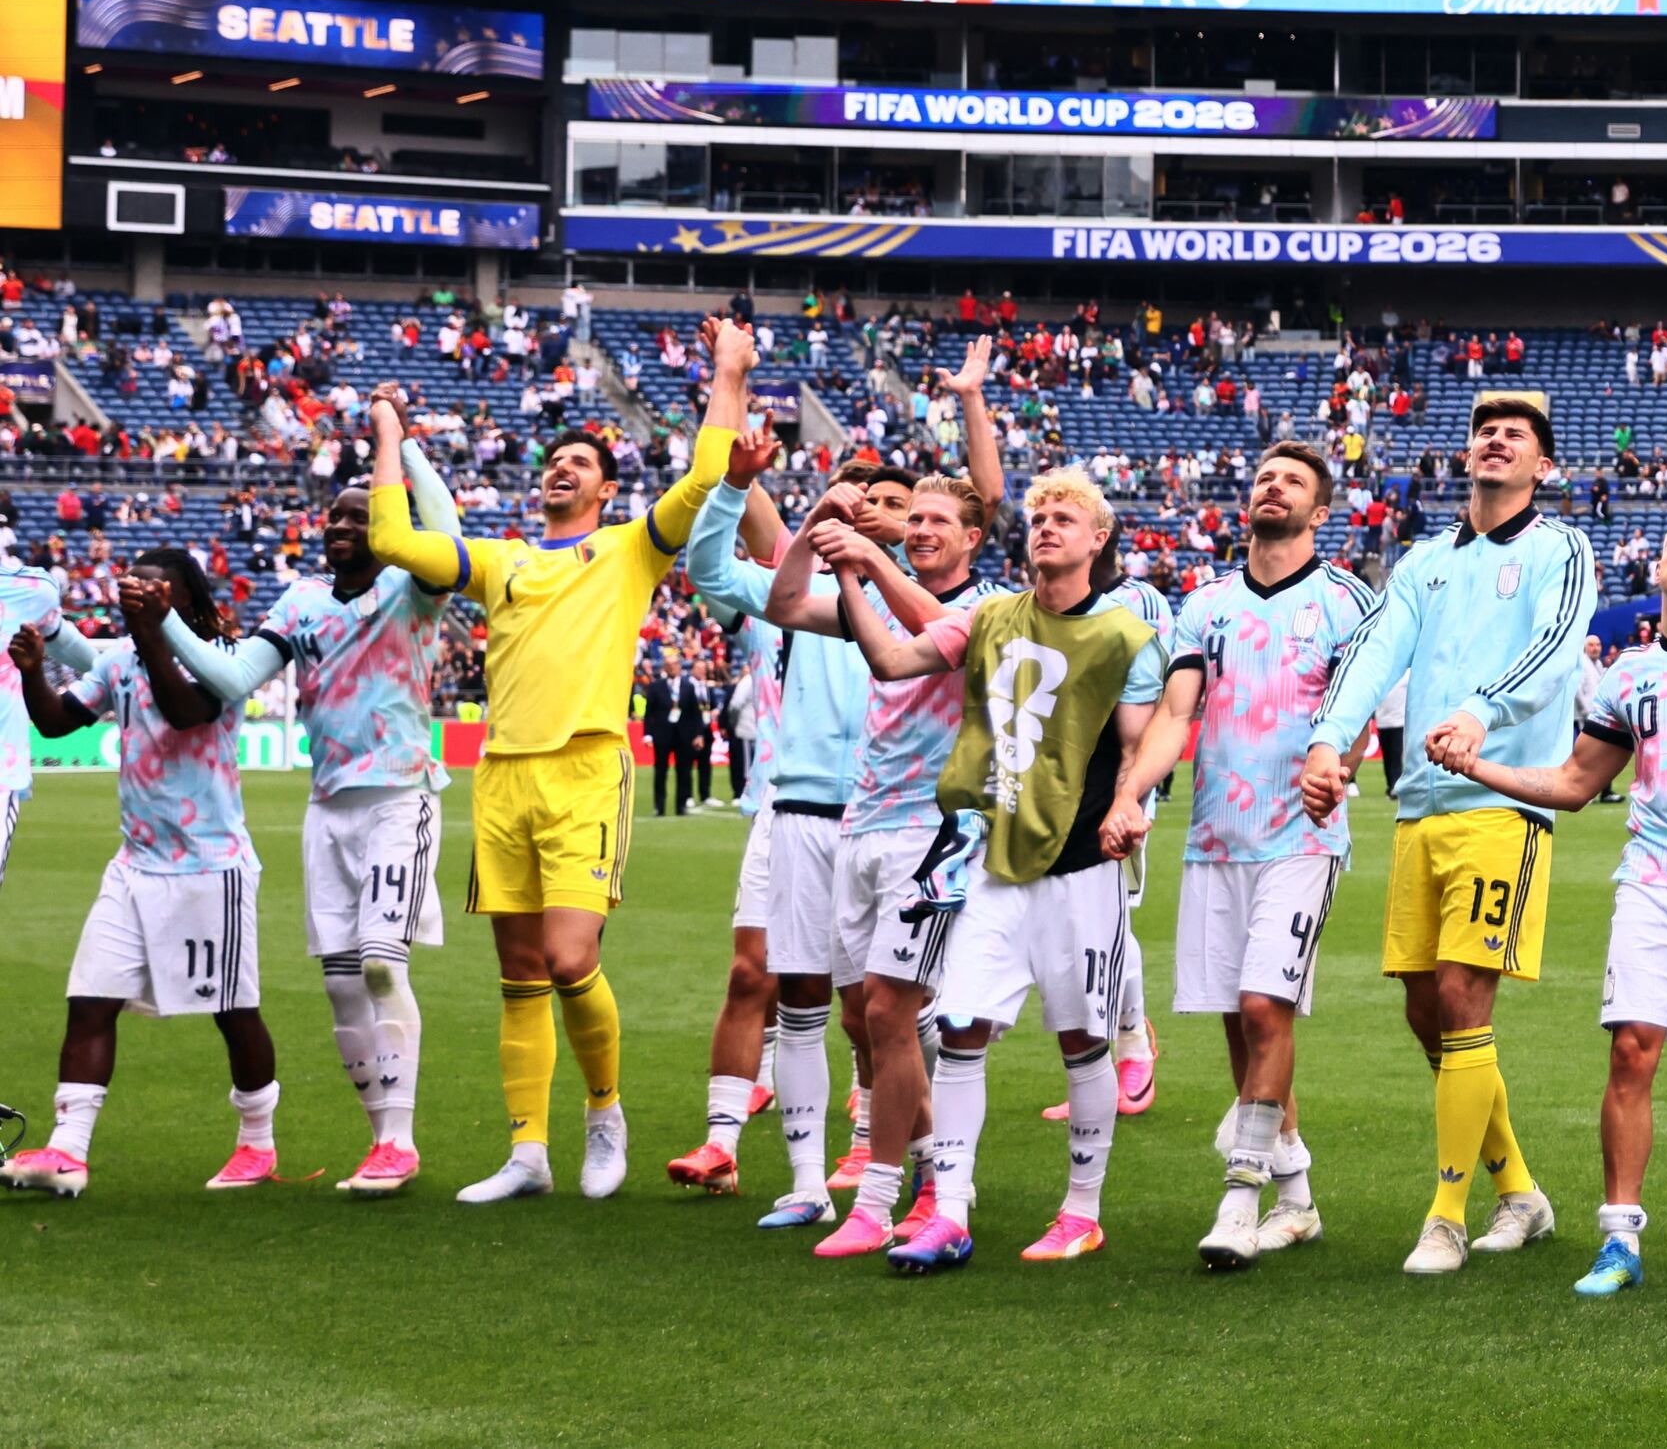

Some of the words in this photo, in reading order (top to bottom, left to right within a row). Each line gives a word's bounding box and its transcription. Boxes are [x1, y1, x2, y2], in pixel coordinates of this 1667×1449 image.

[216, 4, 415, 52] SEATTLE
[844, 92, 922, 124] FIFA
[925, 95, 1053, 126] WORLD
[1056, 96, 1130, 128] CUP
[1132, 98, 1255, 131] 2026
[309, 201, 461, 236] SEATTLE
[1052, 227, 1132, 260] FIFA
[1136, 230, 1281, 262] WORLD
[1287, 230, 1364, 263] CUP
[1369, 231, 1502, 264] 2026
[1207, 635, 1226, 678] 4
[1626, 695, 1657, 739] 10
[599, 822, 607, 861] 1
[372, 864, 404, 903] 14
[1470, 877, 1511, 926] 13
[1290, 912, 1313, 959] 4
[185, 939, 214, 979] 11
[1085, 949, 1107, 996] 18
